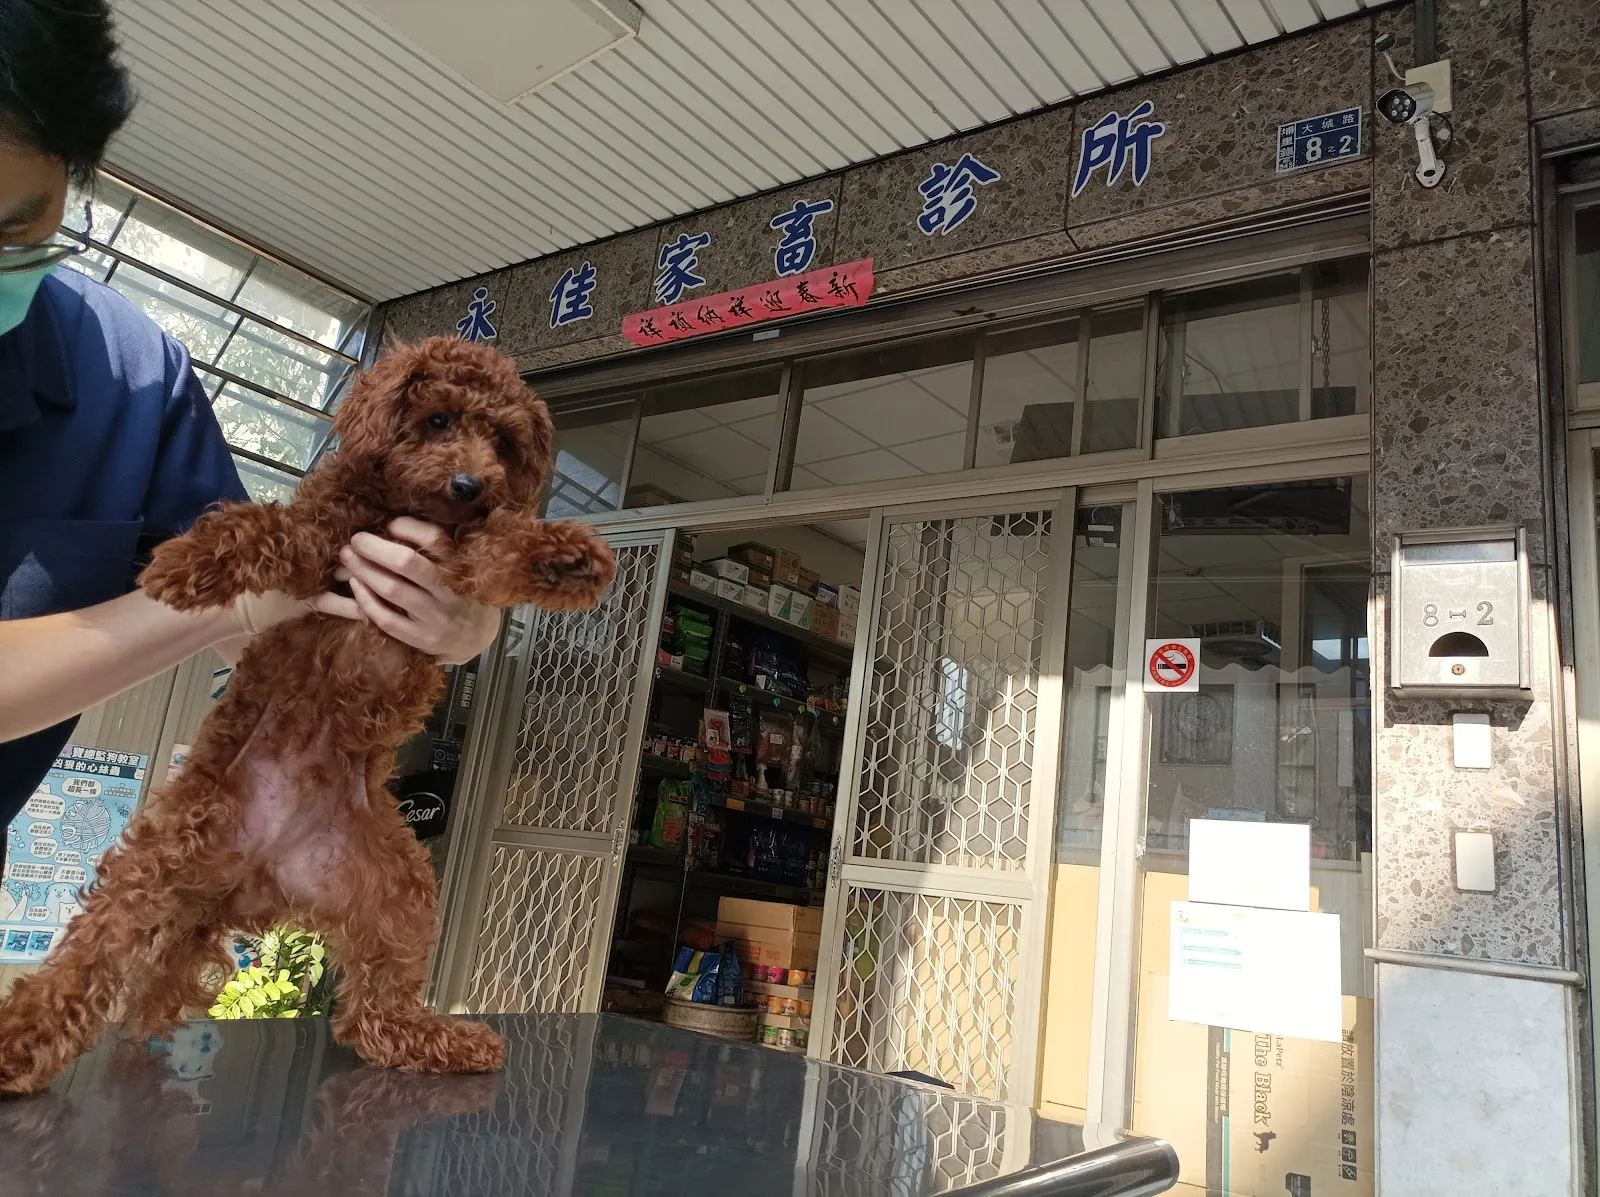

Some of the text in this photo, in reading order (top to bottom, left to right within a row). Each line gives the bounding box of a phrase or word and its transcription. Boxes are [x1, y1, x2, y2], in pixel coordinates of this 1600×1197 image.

[1301, 113, 1356, 135] 大城路
[1305, 134, 1352, 162] 8之2
[456, 99, 1166, 341] 永佳家畜診所
[1422, 600, 1494, 628] 8-2
[1275, 1037, 1284, 1068] LaPetz
[1254, 1034, 1272, 1125] The Black
